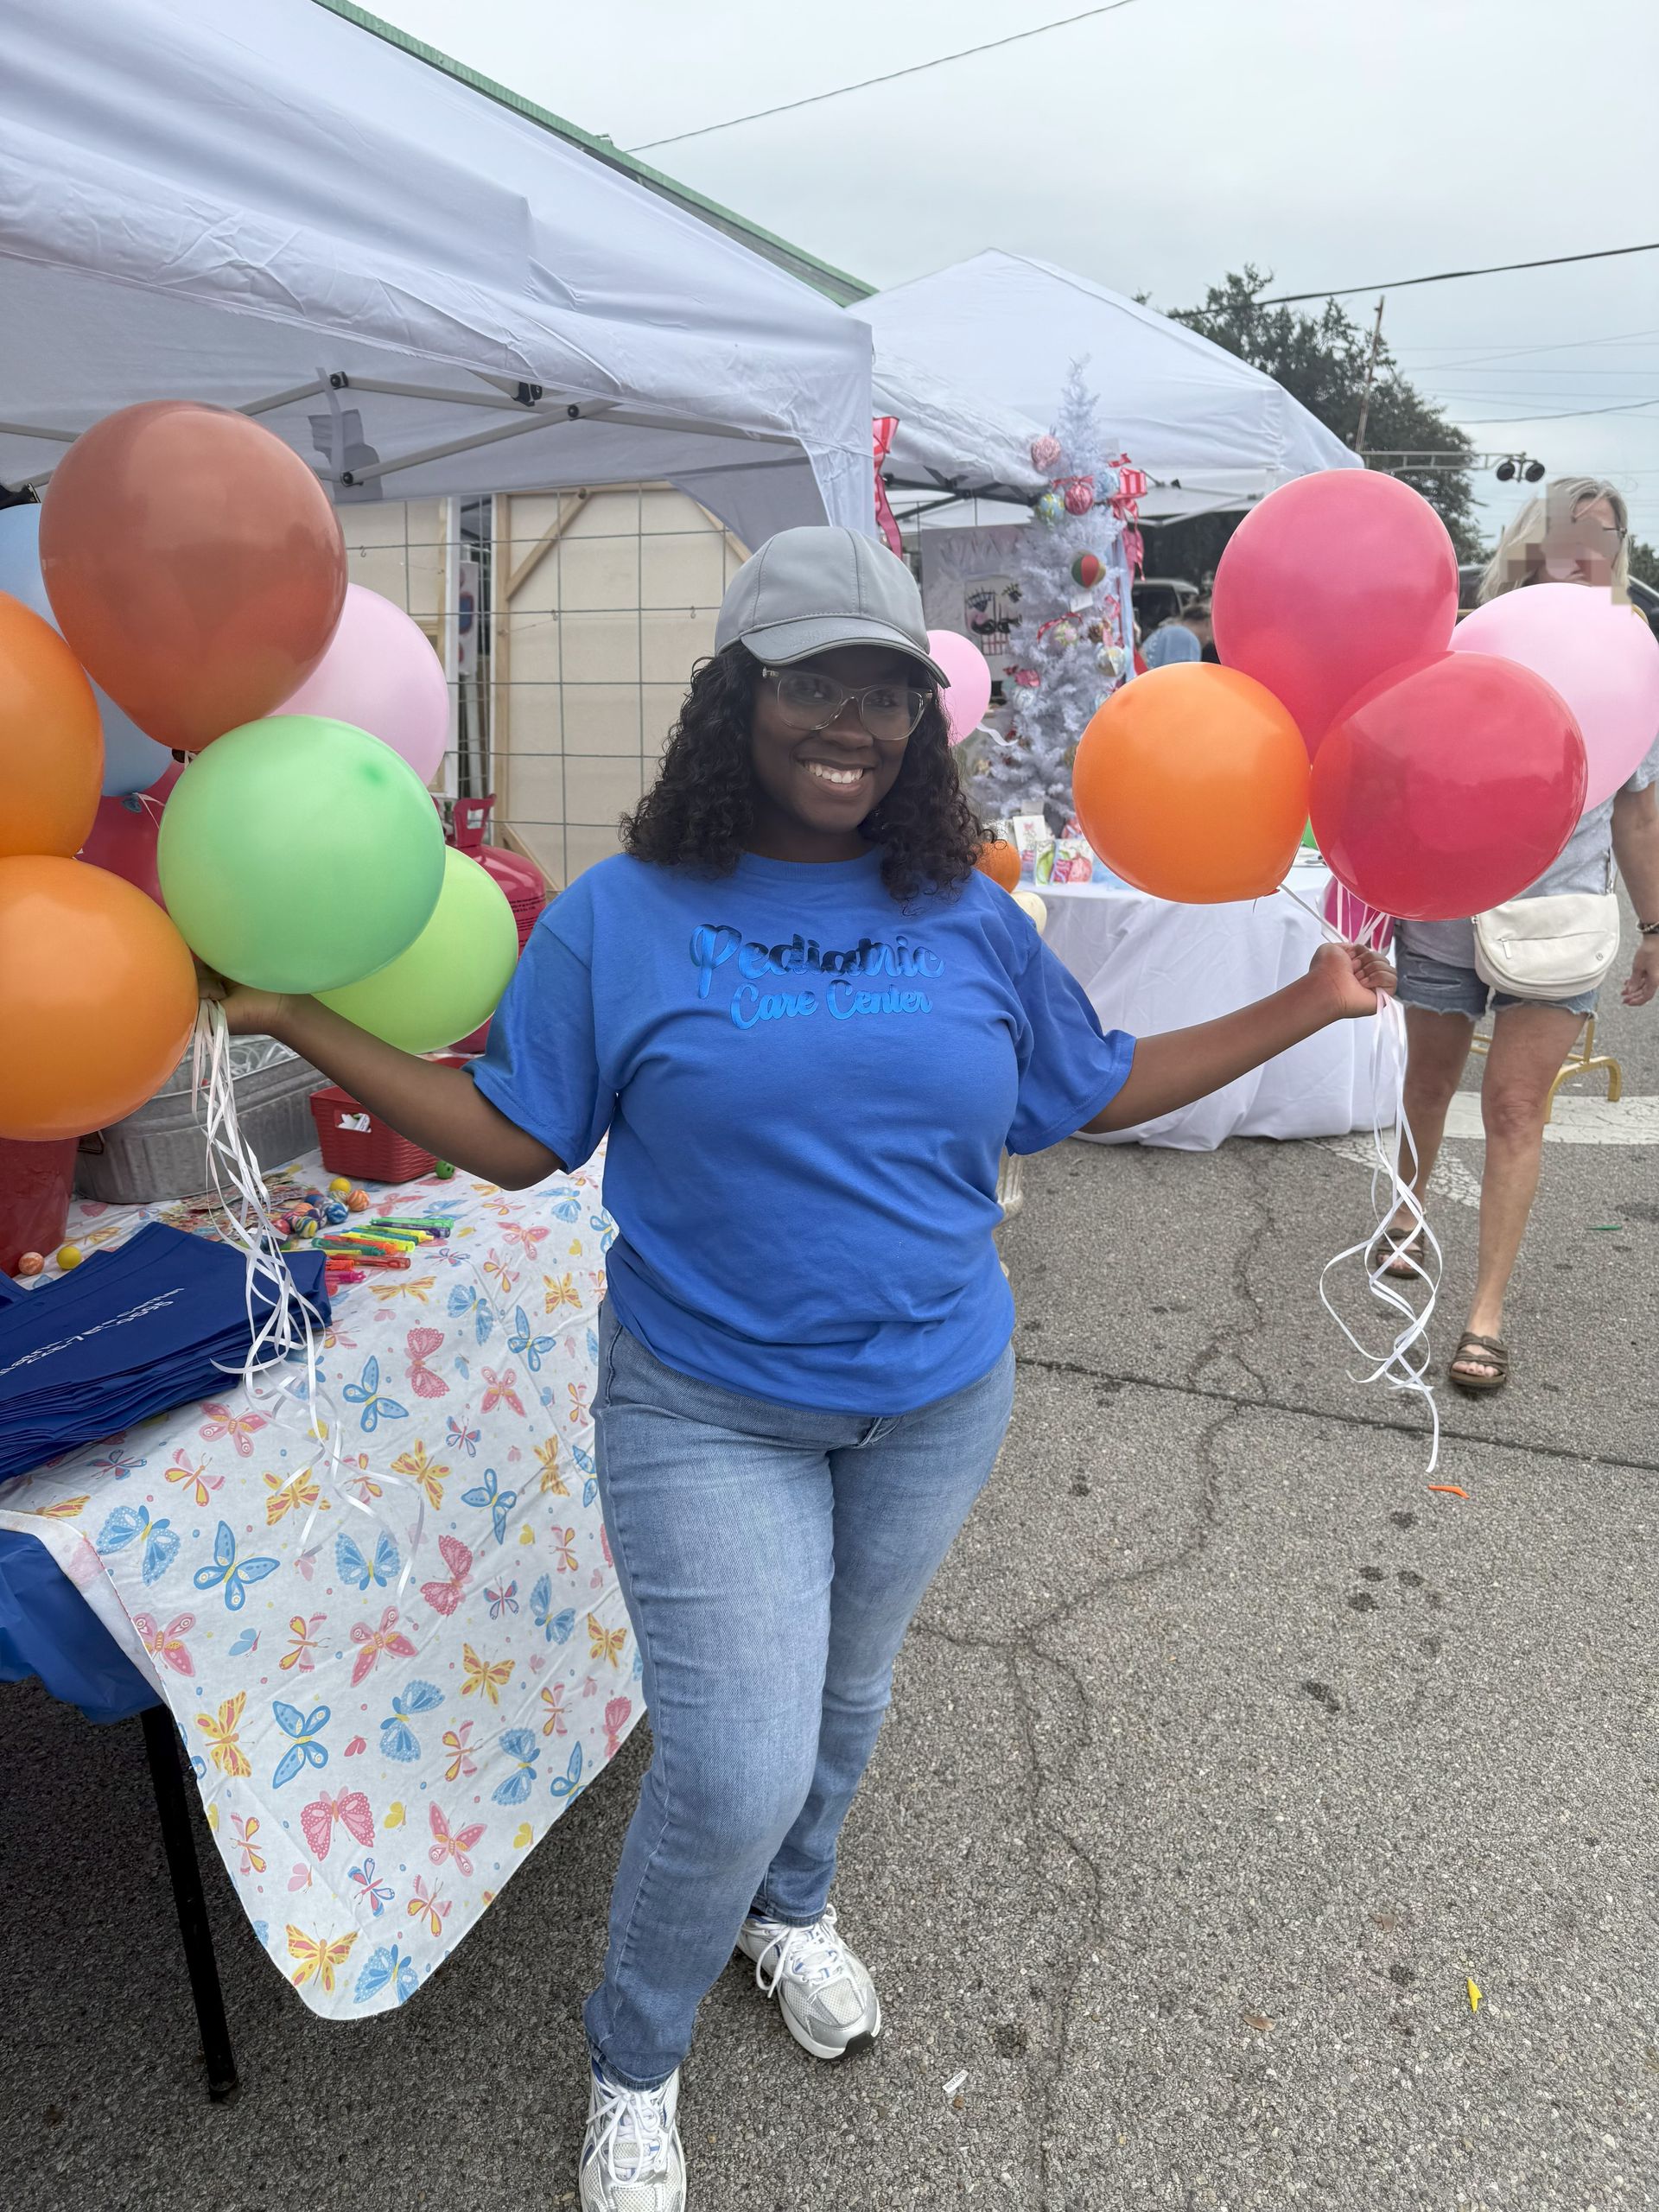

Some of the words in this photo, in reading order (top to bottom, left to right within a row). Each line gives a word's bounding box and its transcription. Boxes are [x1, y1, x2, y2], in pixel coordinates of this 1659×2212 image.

[690, 924, 944, 999] Pediatric
[731, 982, 819, 1030] Care
[827, 979, 933, 1020] Center
